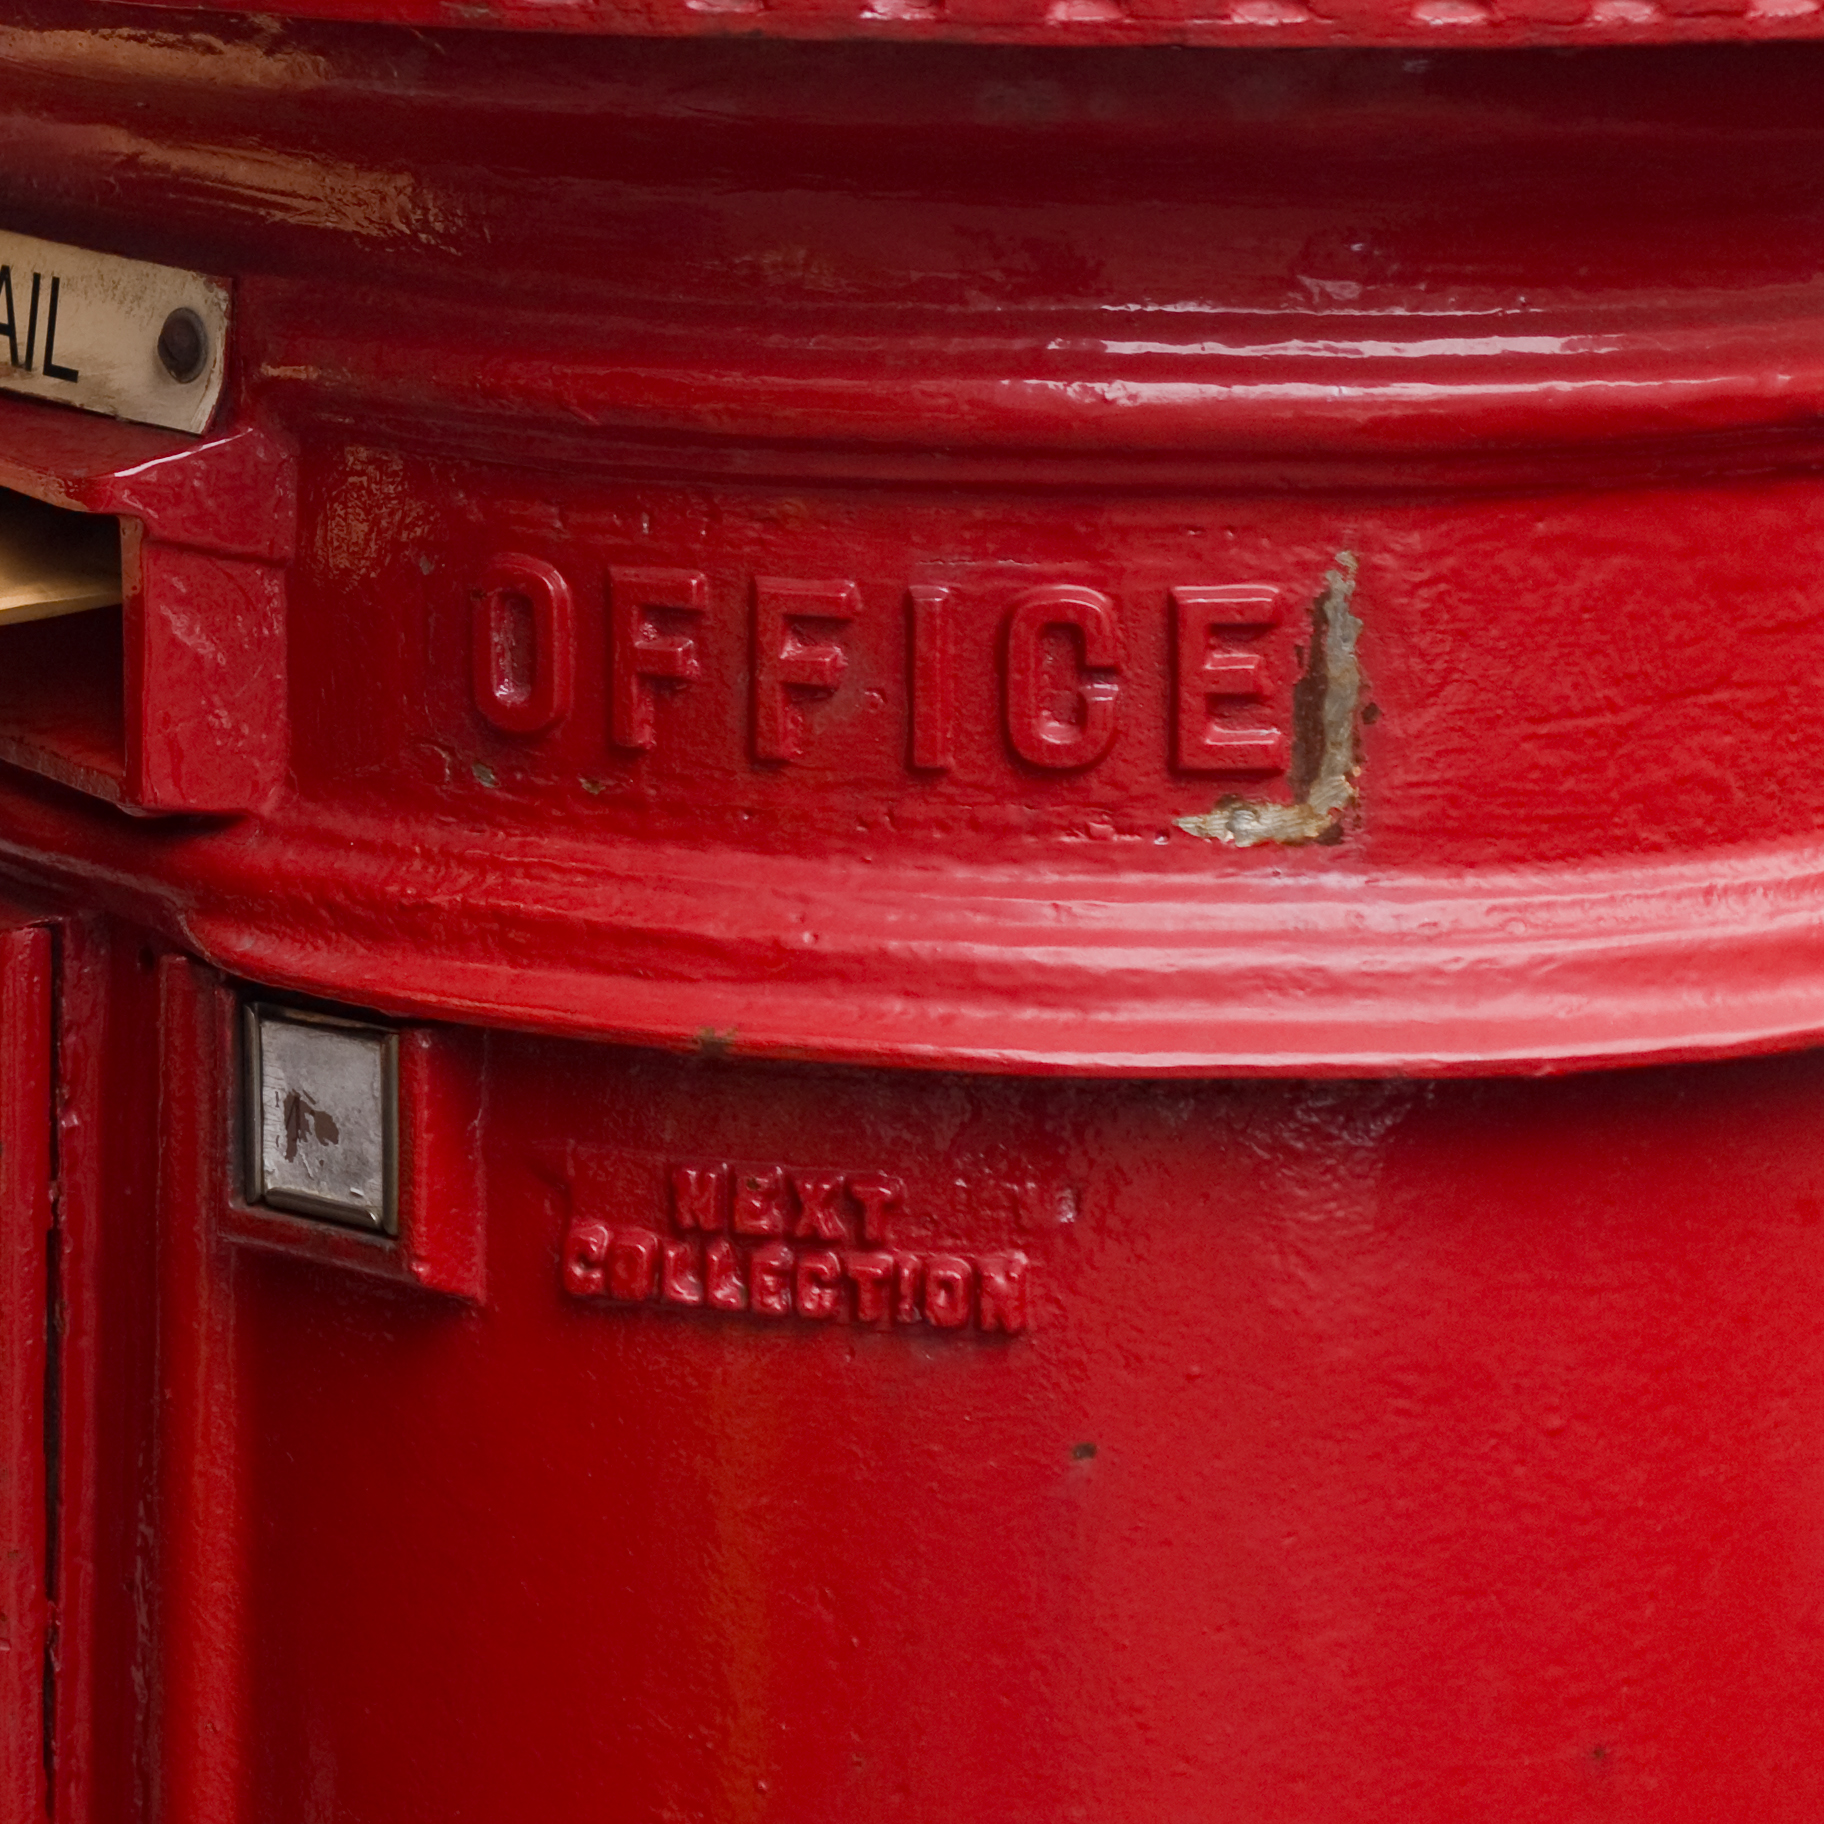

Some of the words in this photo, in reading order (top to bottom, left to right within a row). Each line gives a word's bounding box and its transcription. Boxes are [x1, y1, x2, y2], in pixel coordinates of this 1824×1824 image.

[472, 554, 1284, 772] OFFICE
[674, 1164, 905, 1240] NEXT
[562, 1220, 1028, 1332] COLLECTION
